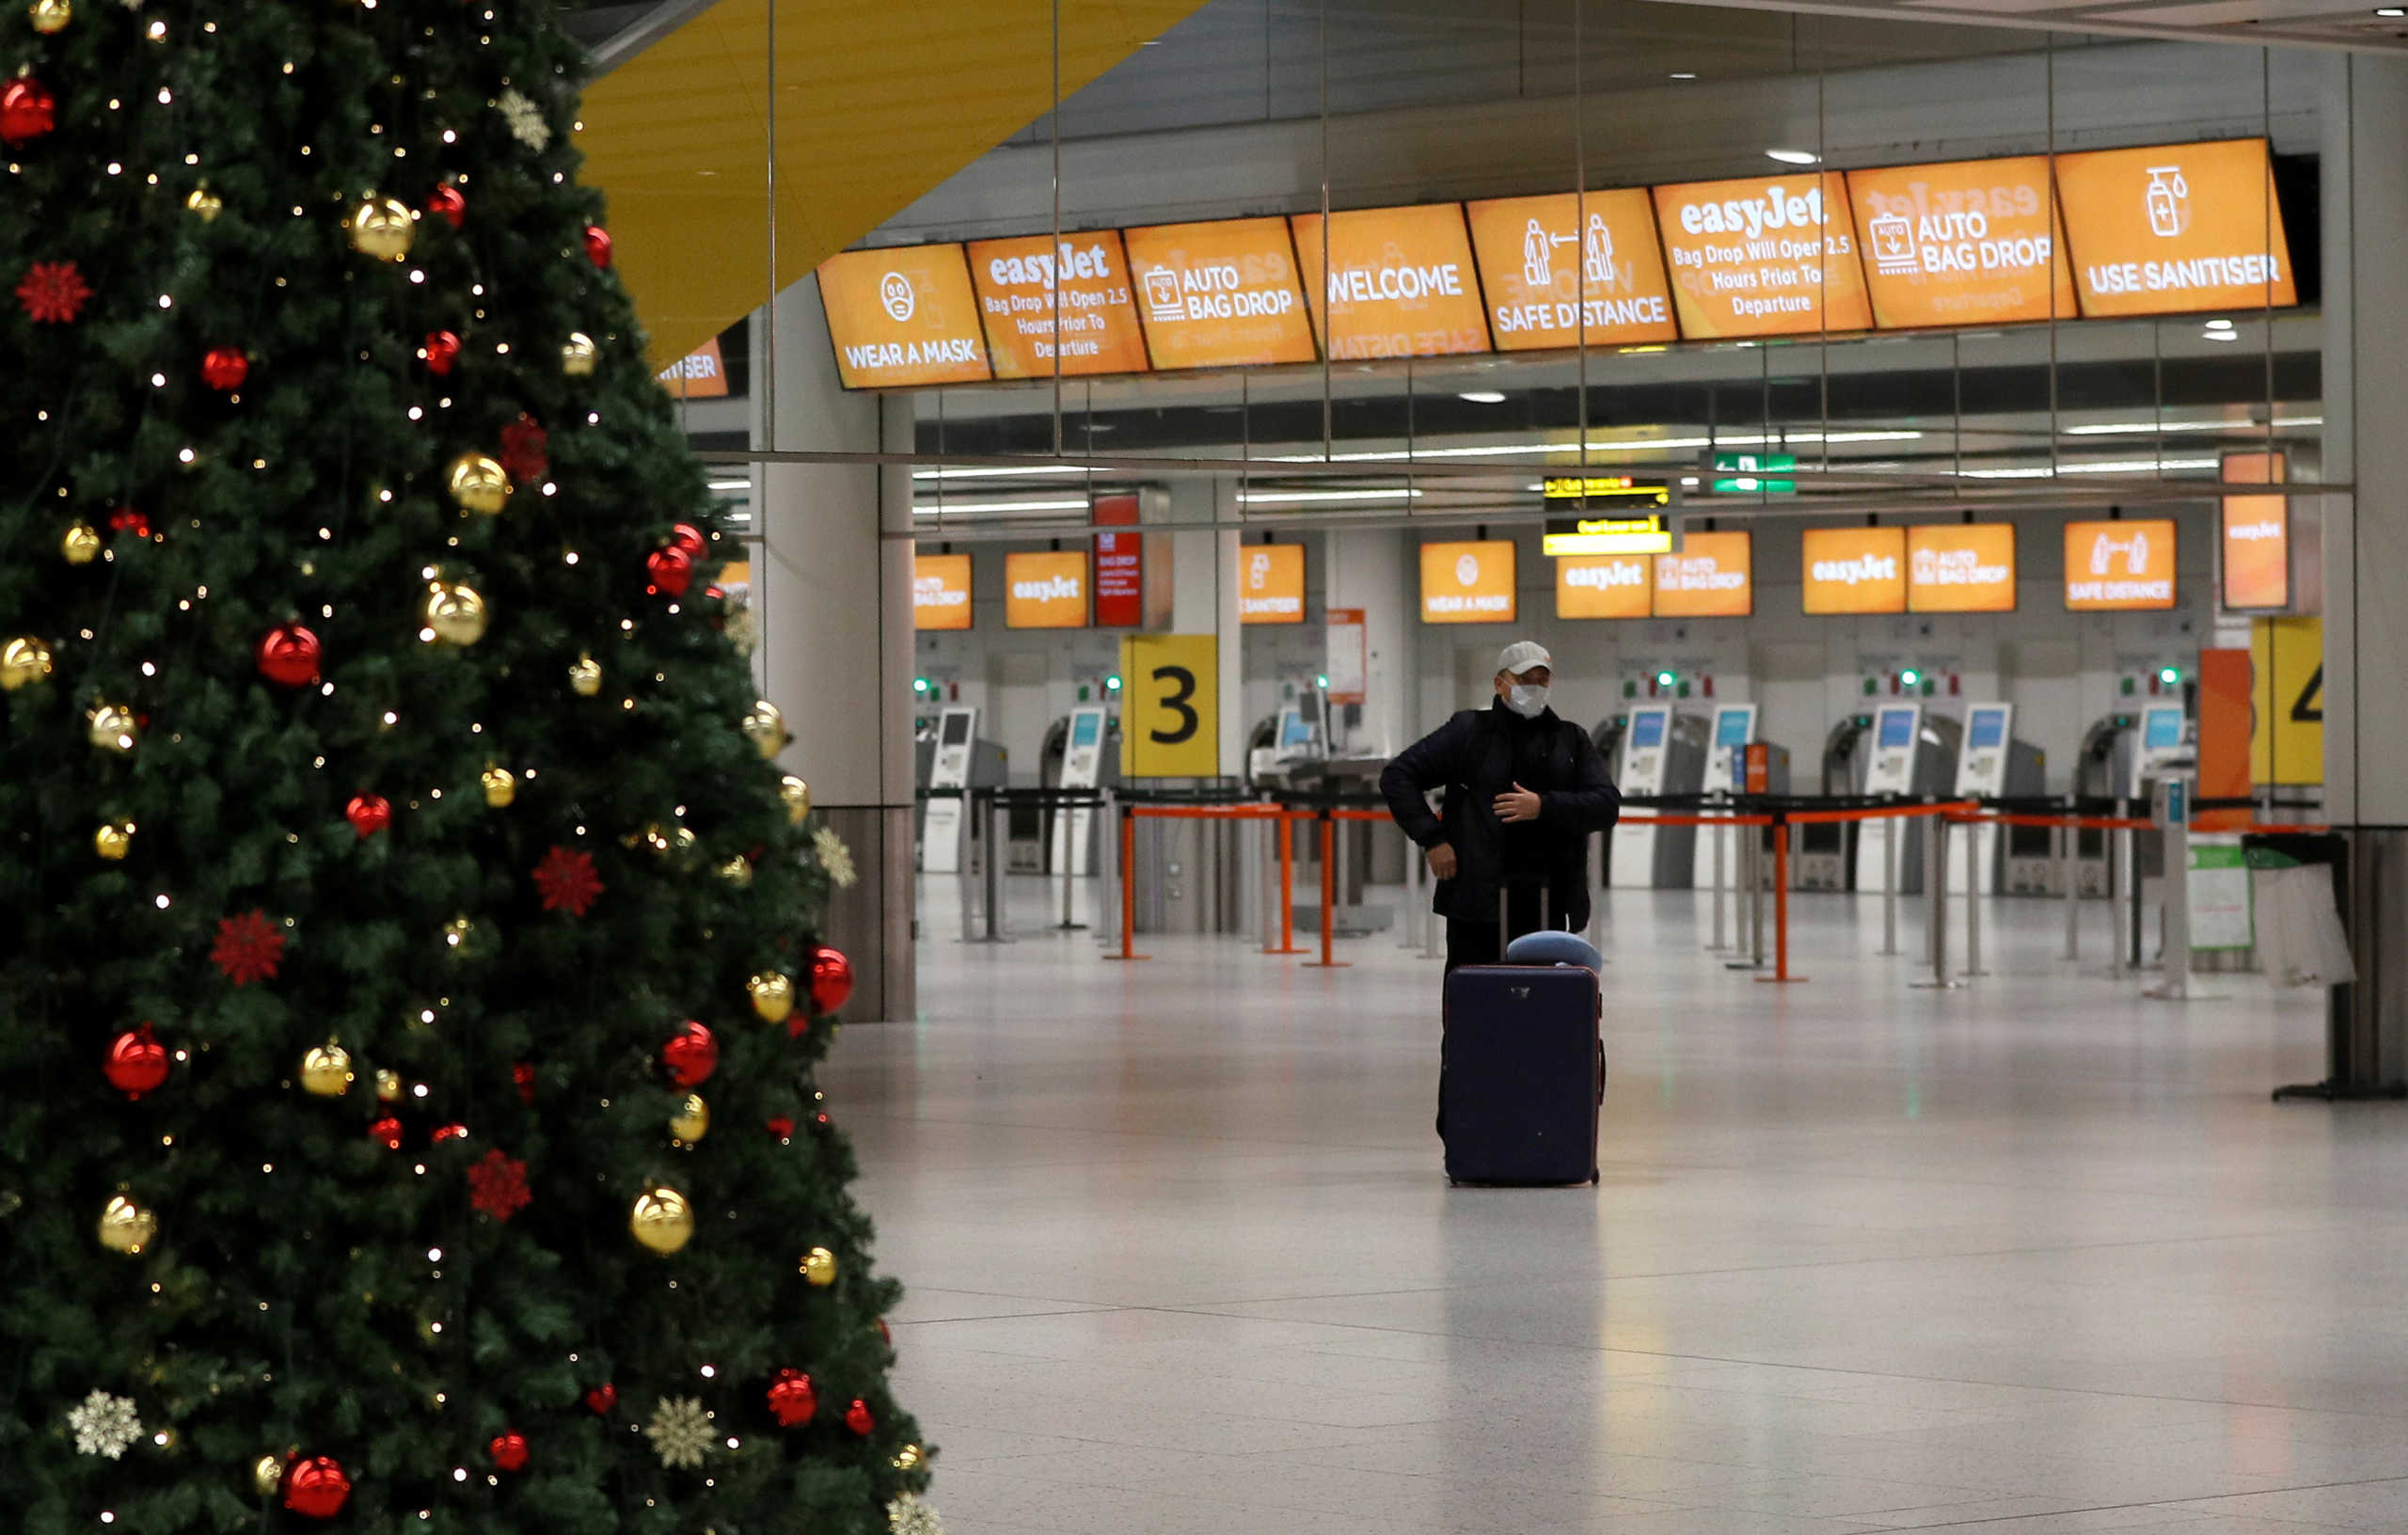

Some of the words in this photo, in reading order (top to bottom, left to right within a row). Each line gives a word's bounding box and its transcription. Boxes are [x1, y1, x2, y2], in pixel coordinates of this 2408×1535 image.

[1681, 186, 1830, 240] easyJet
[1919, 210, 1988, 242] AUTO
[990, 243, 1111, 290] easyJet
[1672, 246, 1703, 269] Bag
[1704, 244, 1745, 266] Drop
[1746, 240, 1777, 261] Will
[1825, 234, 1851, 255] 2.5
[1921, 243, 1977, 273] BAG
[1978, 236, 2052, 270] DROP
[1183, 265, 1240, 293] AUTO
[1326, 263, 1464, 304] WELCOME
[1710, 271, 1758, 291] Hours
[1760, 267, 1798, 287] Prior
[1799, 263, 1822, 284] To
[2087, 263, 2142, 293] USE
[2144, 253, 2280, 290] SANITISER
[985, 295, 1010, 317] Bag
[1010, 293, 1043, 314] Drop
[1070, 290, 1106, 310] Open
[1106, 288, 1128, 305] 2.5
[1186, 295, 1233, 320] BAG
[1233, 289, 1293, 318] DROP
[1497, 304, 1555, 332] SAFE
[1556, 296, 1667, 329] DISTANCE
[1732, 295, 1812, 319] Departure
[1086, 312, 1106, 330] To
[845, 342, 905, 370] WEAR
[907, 341, 922, 365] A
[922, 339, 978, 364] MASK
[1565, 561, 1644, 591] easyJet
[1813, 553, 1897, 585] easyJet
[1013, 575, 1080, 603] easyJet
[1150, 665, 1199, 744] 3
